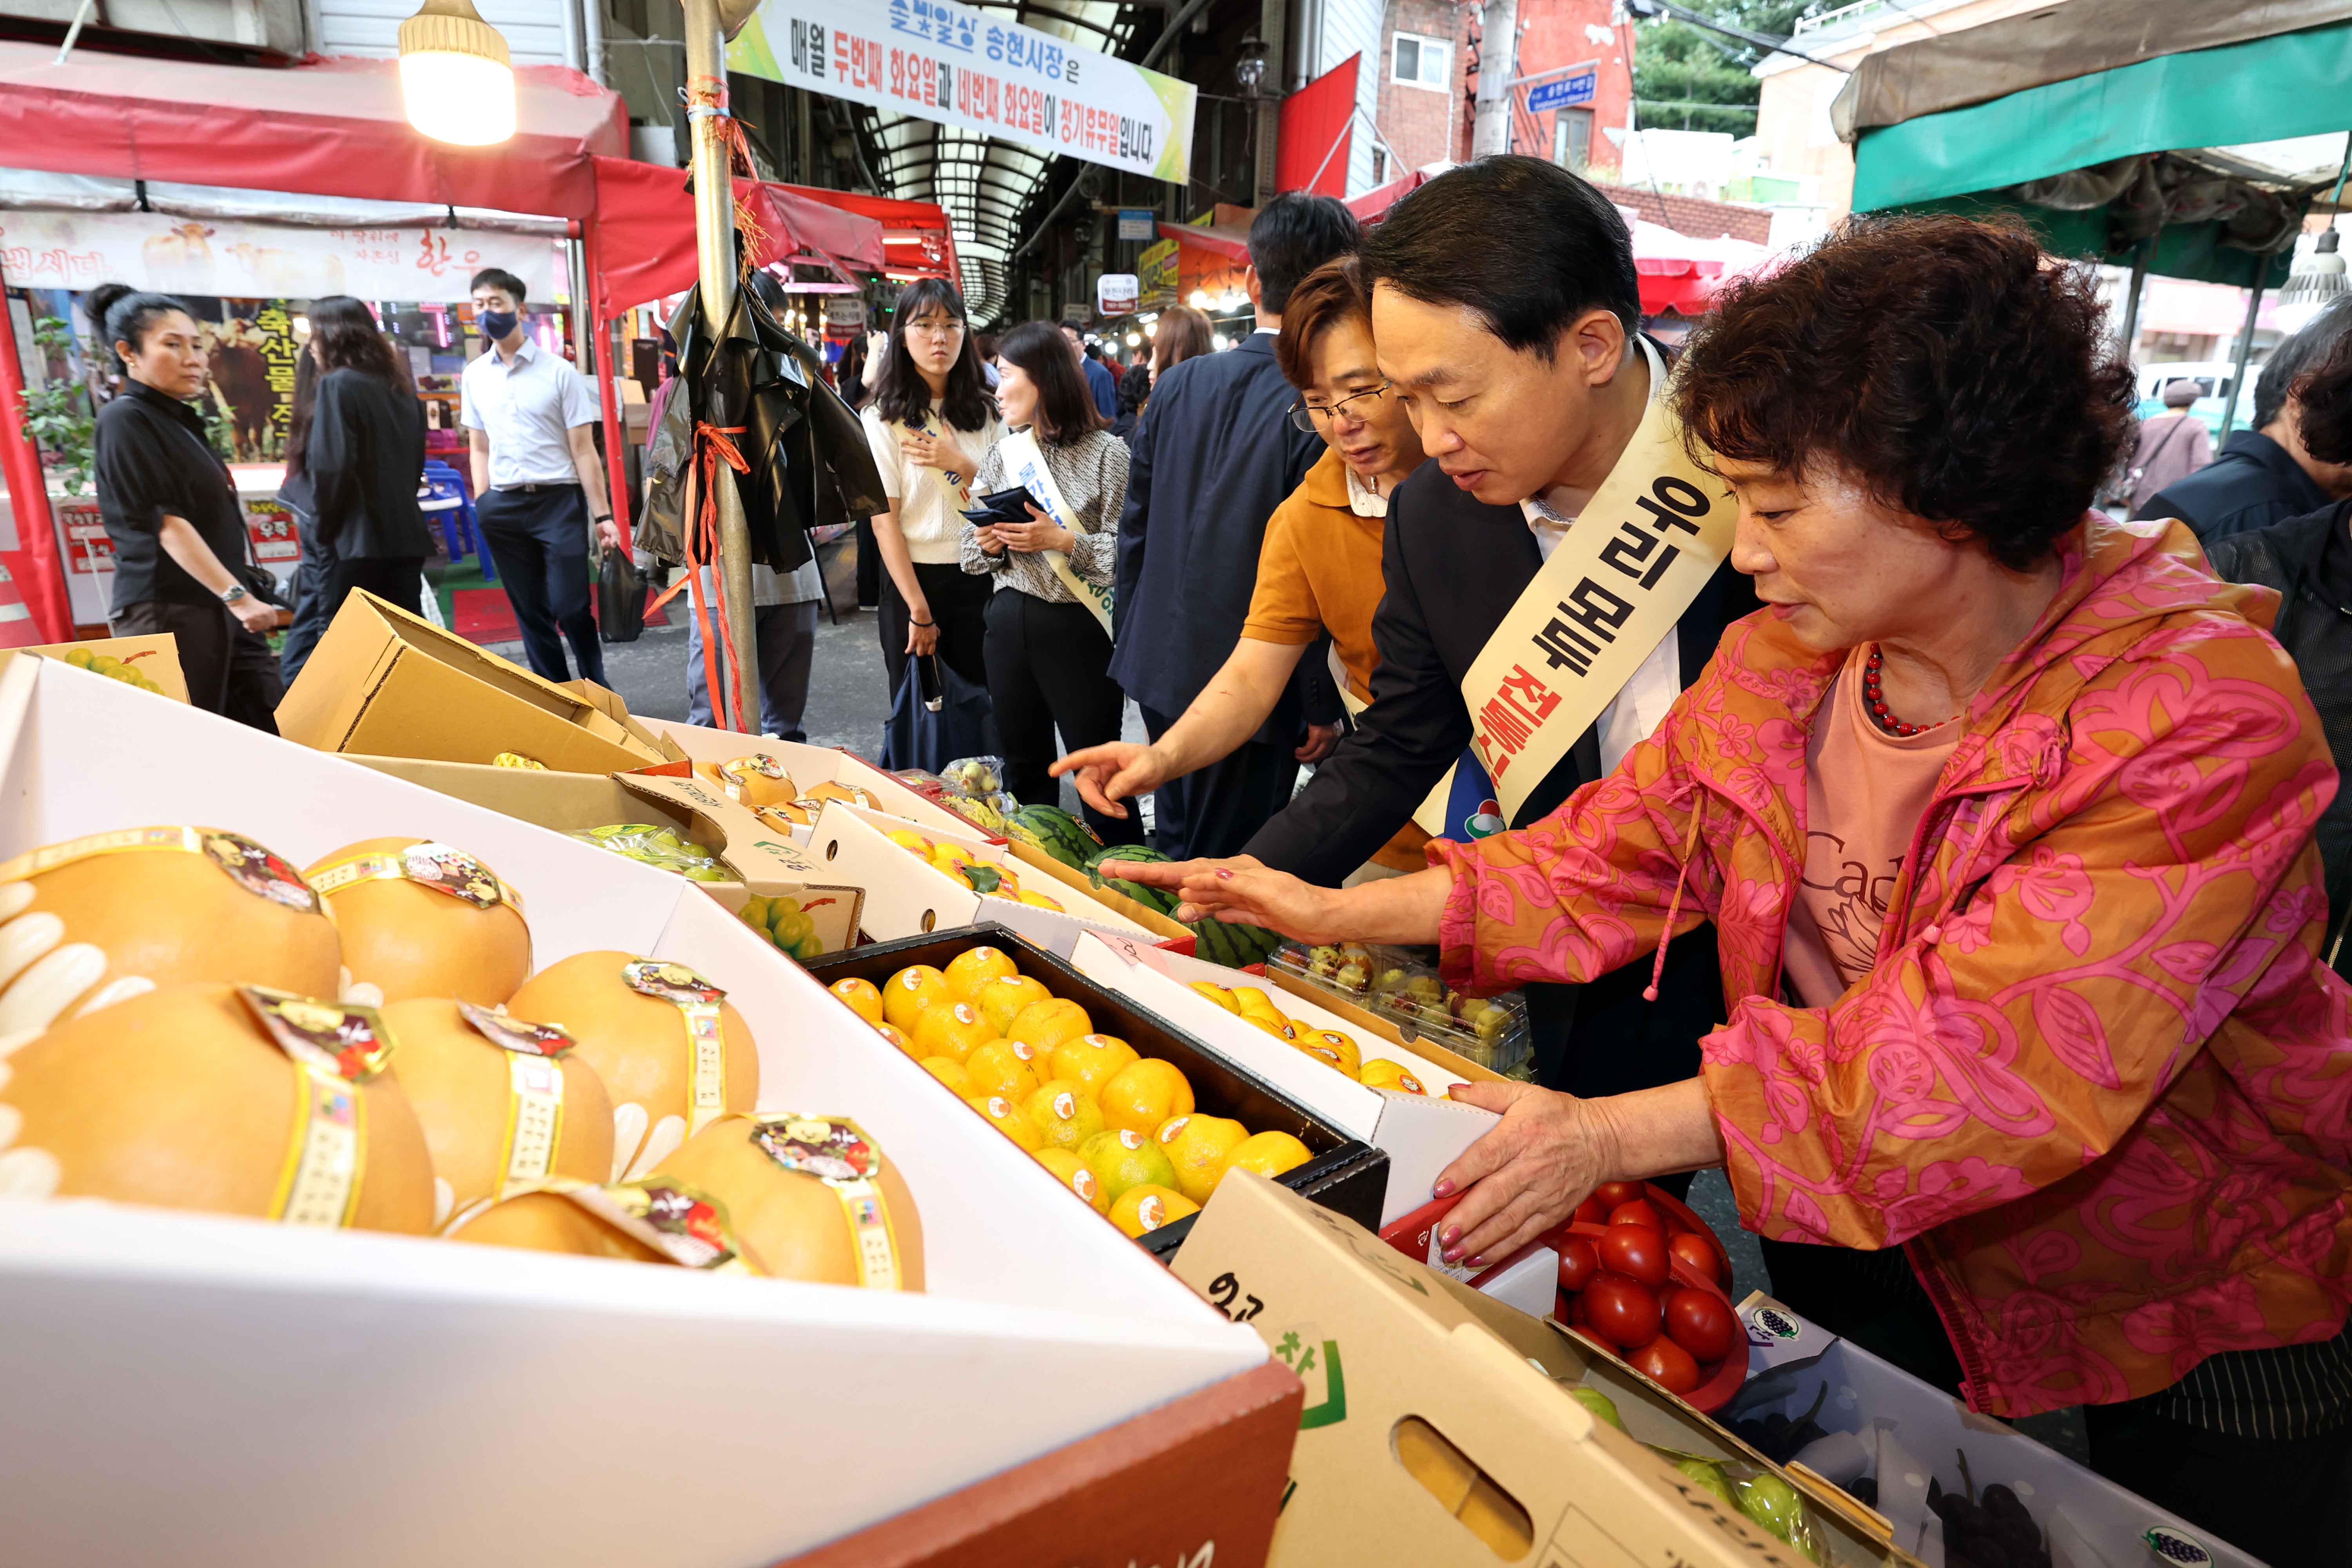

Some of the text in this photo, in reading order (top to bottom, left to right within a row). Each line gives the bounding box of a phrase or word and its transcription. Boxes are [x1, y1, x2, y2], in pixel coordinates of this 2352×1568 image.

[791, 18, 825, 78] 매월
[833, 30, 882, 94] 두번째
[890, 46, 951, 111] 화요일과
[957, 66, 999, 123] 네번째
[1004, 82, 1056, 139] 화요일이
[986, 25, 1080, 84] 송현시장은
[417, 228, 488, 276] 한우
[256, 309, 298, 393] 축산물
[1476, 475, 1711, 791] 우리 모두 전통시
